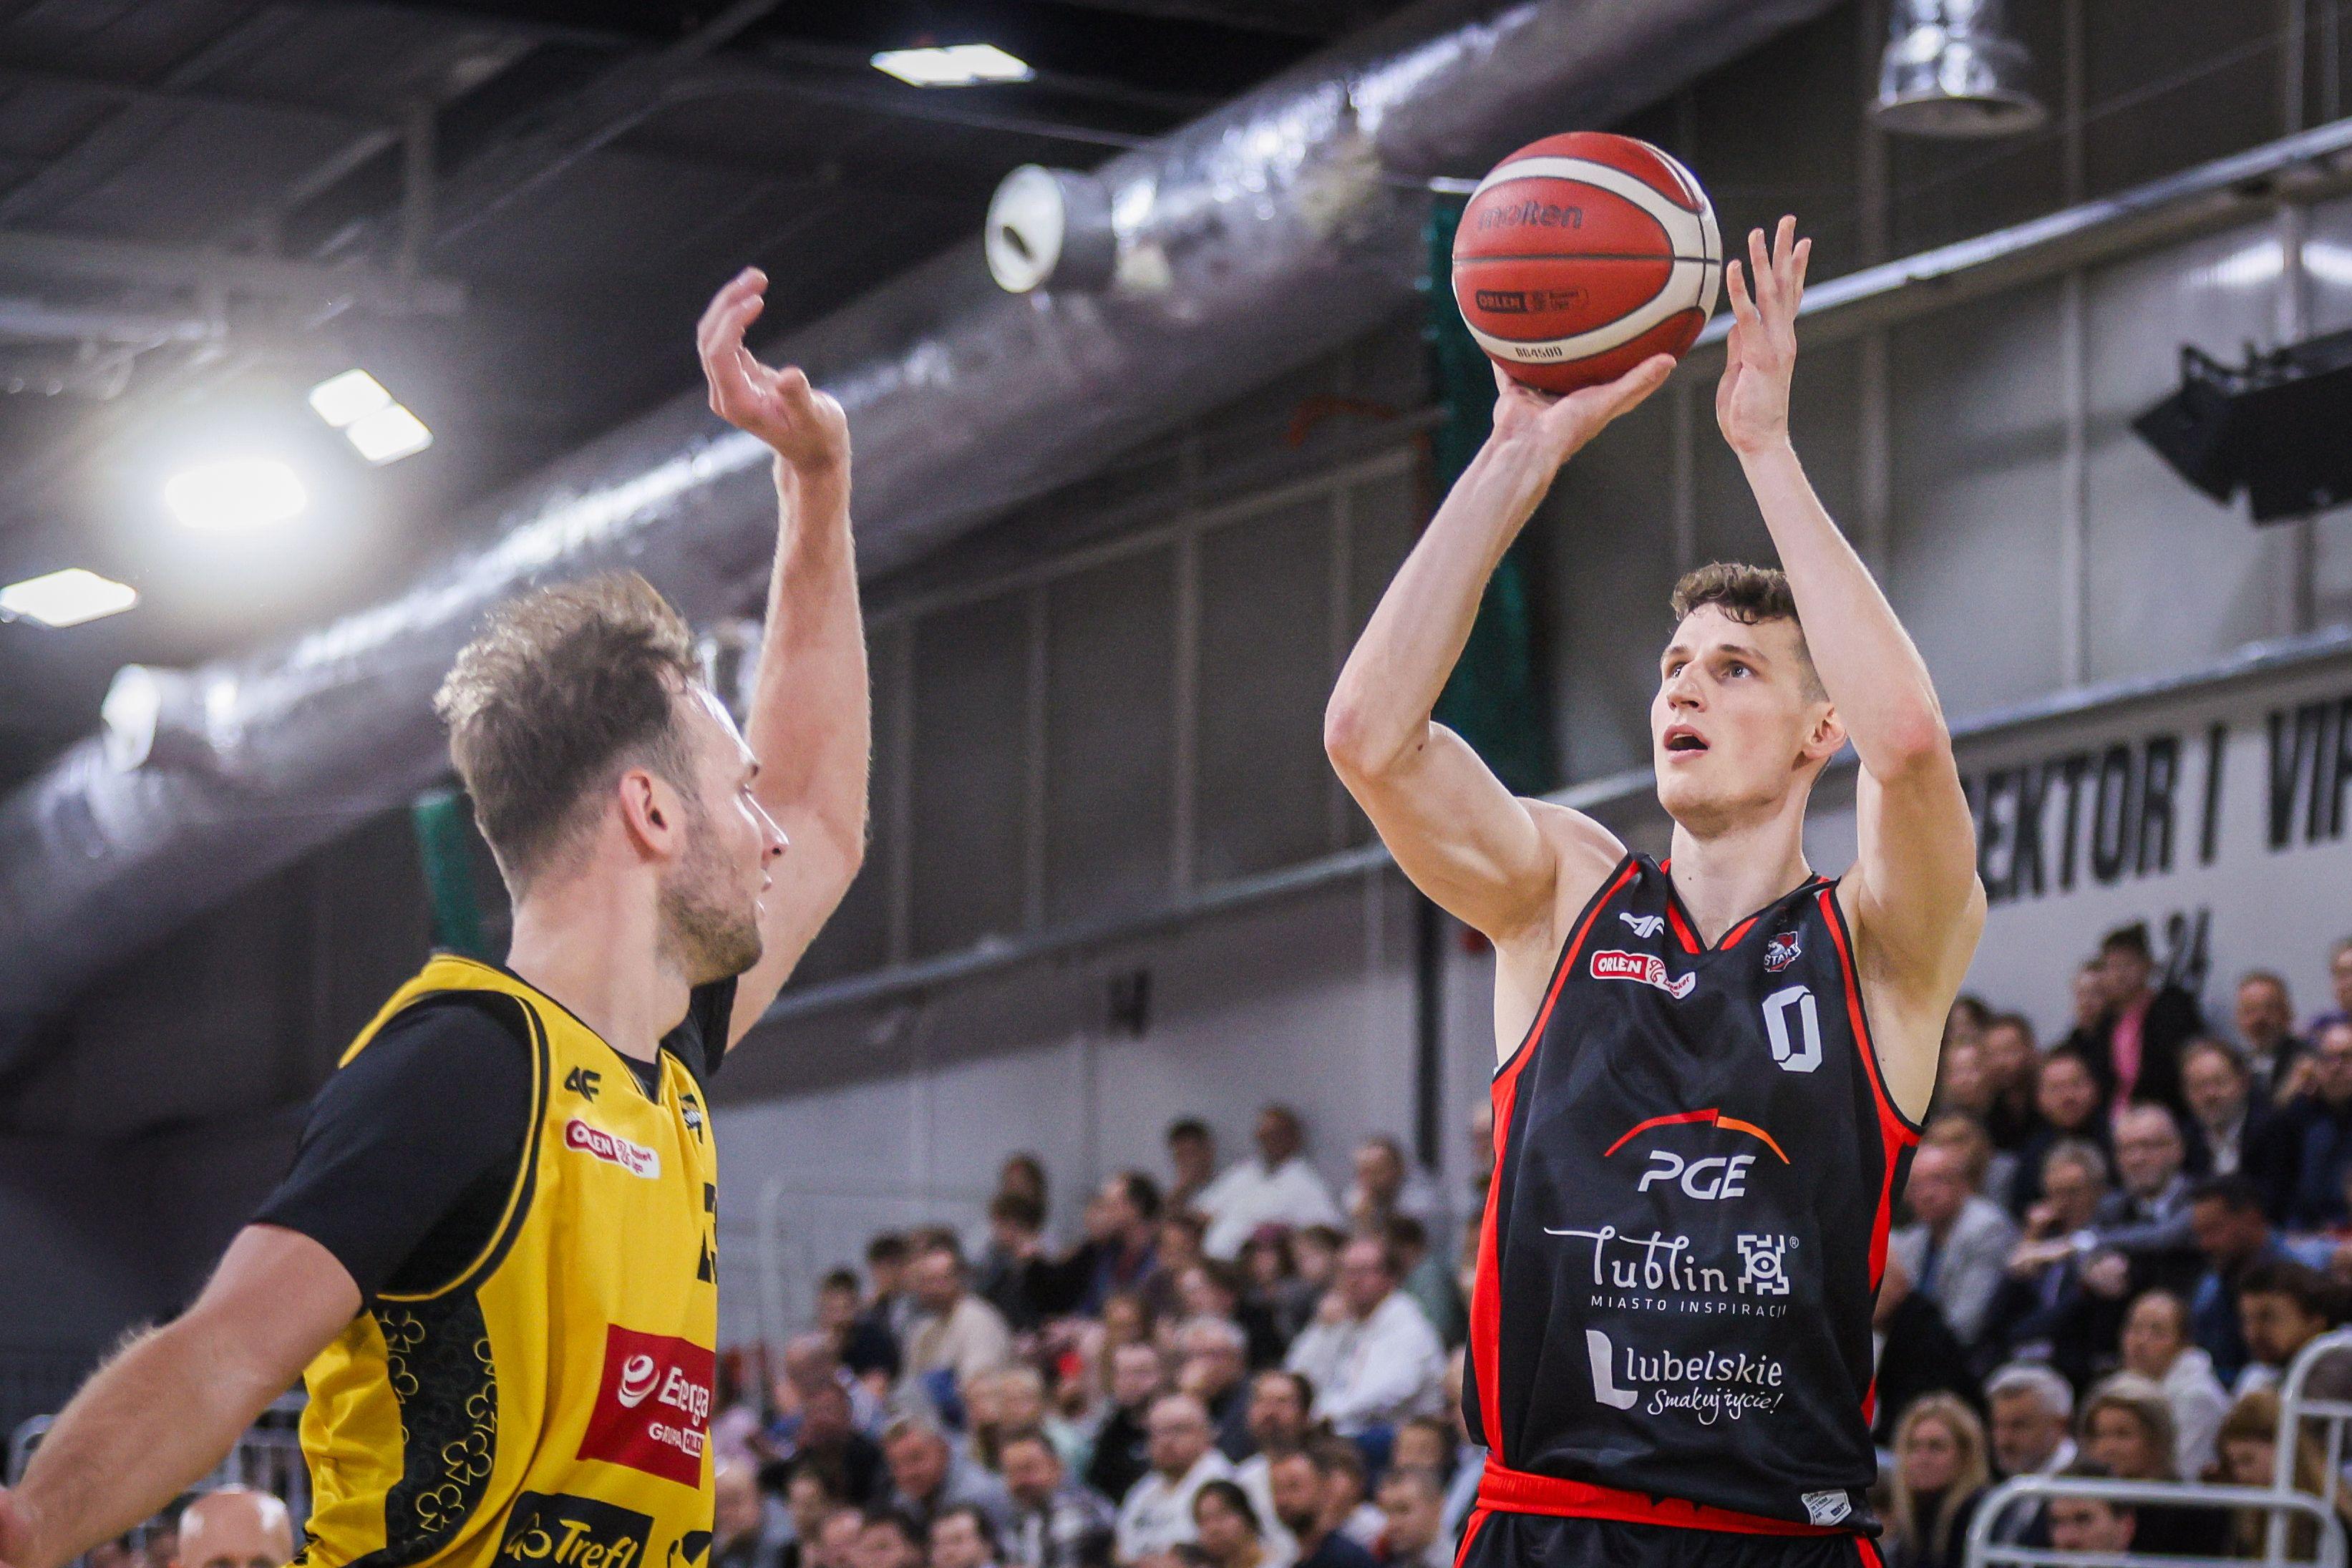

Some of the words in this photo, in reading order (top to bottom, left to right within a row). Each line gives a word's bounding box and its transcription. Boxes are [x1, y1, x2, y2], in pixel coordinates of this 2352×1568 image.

[1478, 200, 1583, 230] molten
[1961, 736, 2178, 899] EKTOR
[1598, 956, 1642, 974] ORLEN
[1762, 985, 1822, 1072] 0
[1638, 1149, 1756, 1200] PGE
[1591, 1295, 1667, 1311] MIASTO
[1647, 1386, 1721, 1426] Smakuj
[554, 1519, 639, 1568] Trefl
